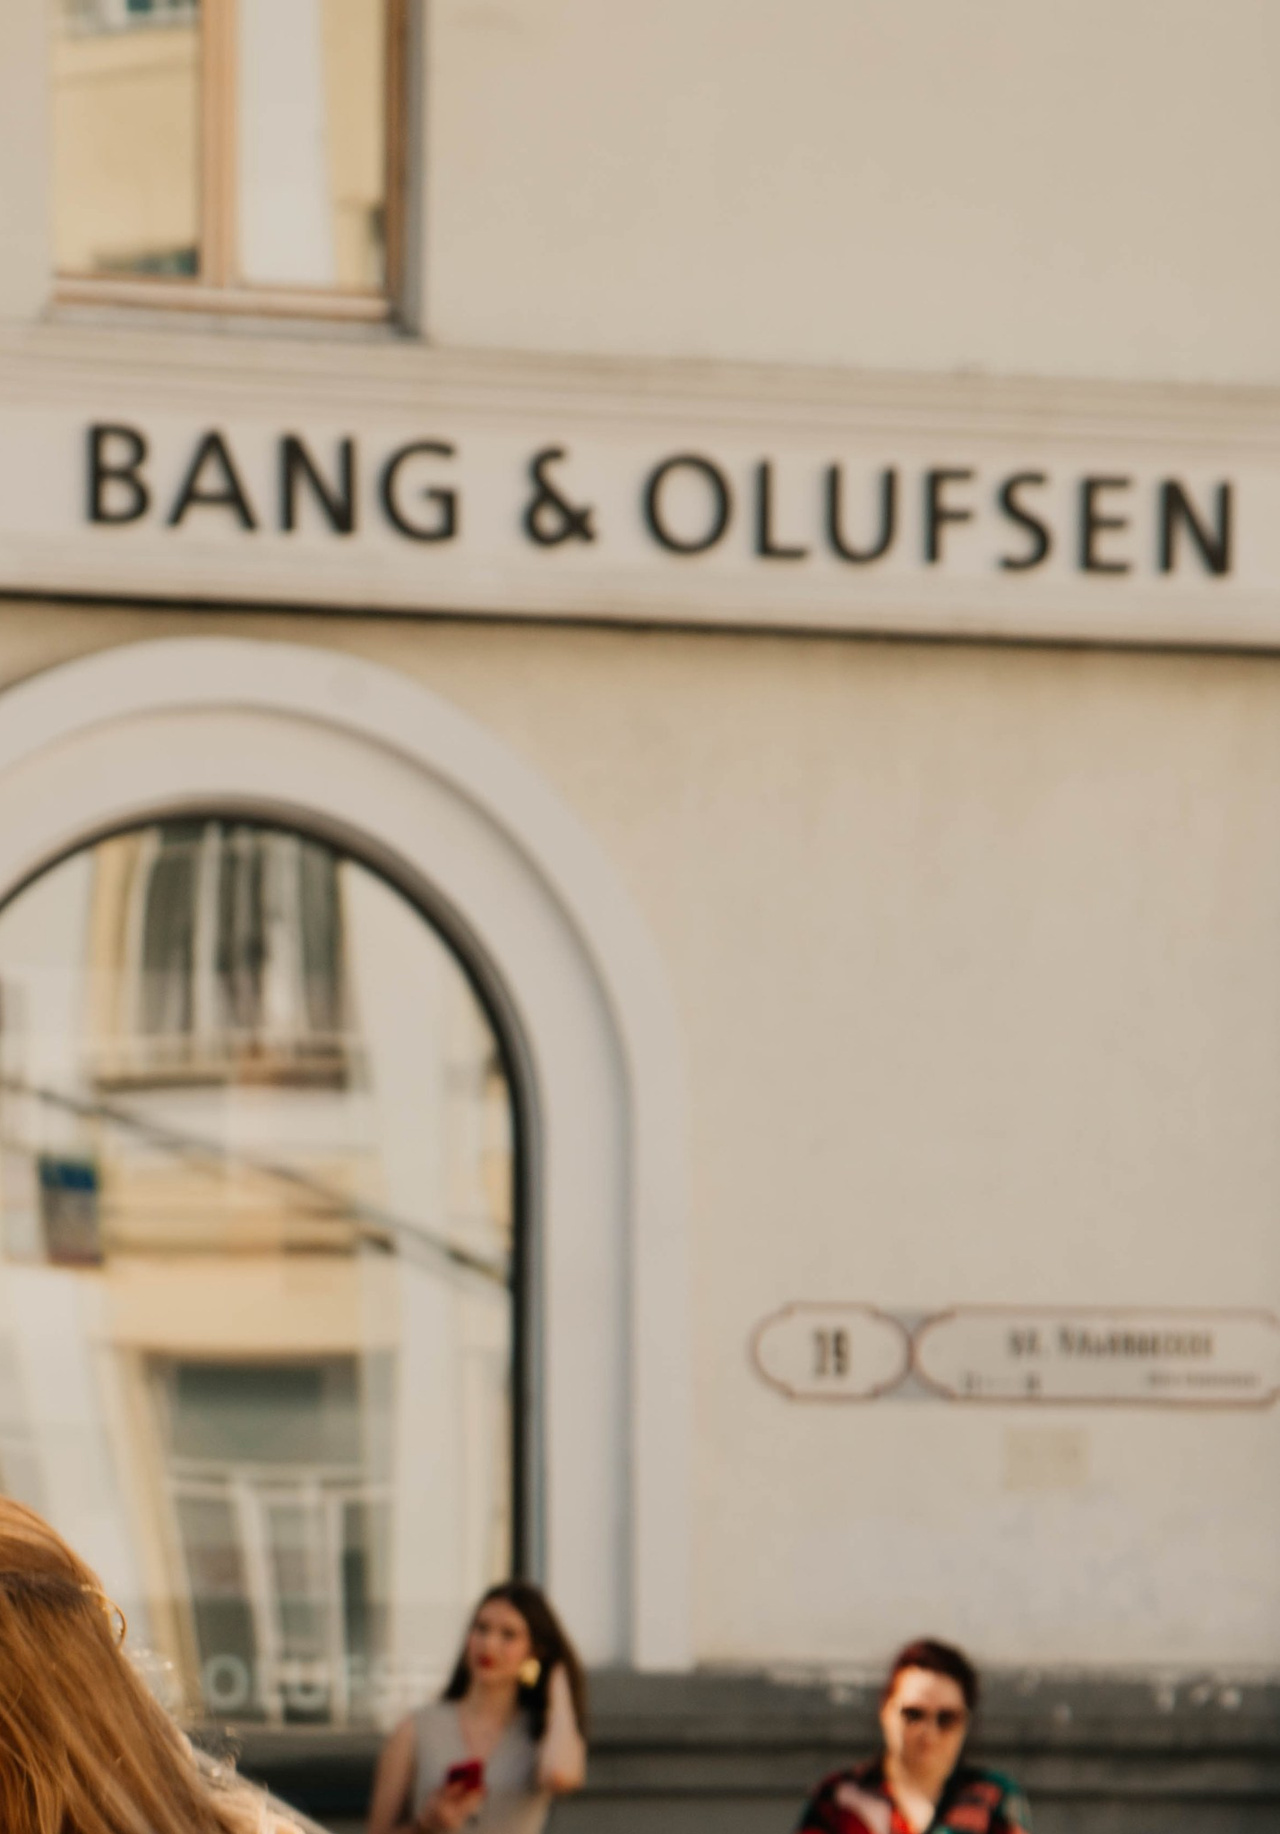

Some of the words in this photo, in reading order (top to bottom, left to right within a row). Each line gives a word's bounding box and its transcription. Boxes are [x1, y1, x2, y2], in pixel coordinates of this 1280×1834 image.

[84, 422, 460, 546] BANG
[520, 446, 598, 550] &
[640, 452, 1234, 579] OLUFSEN
